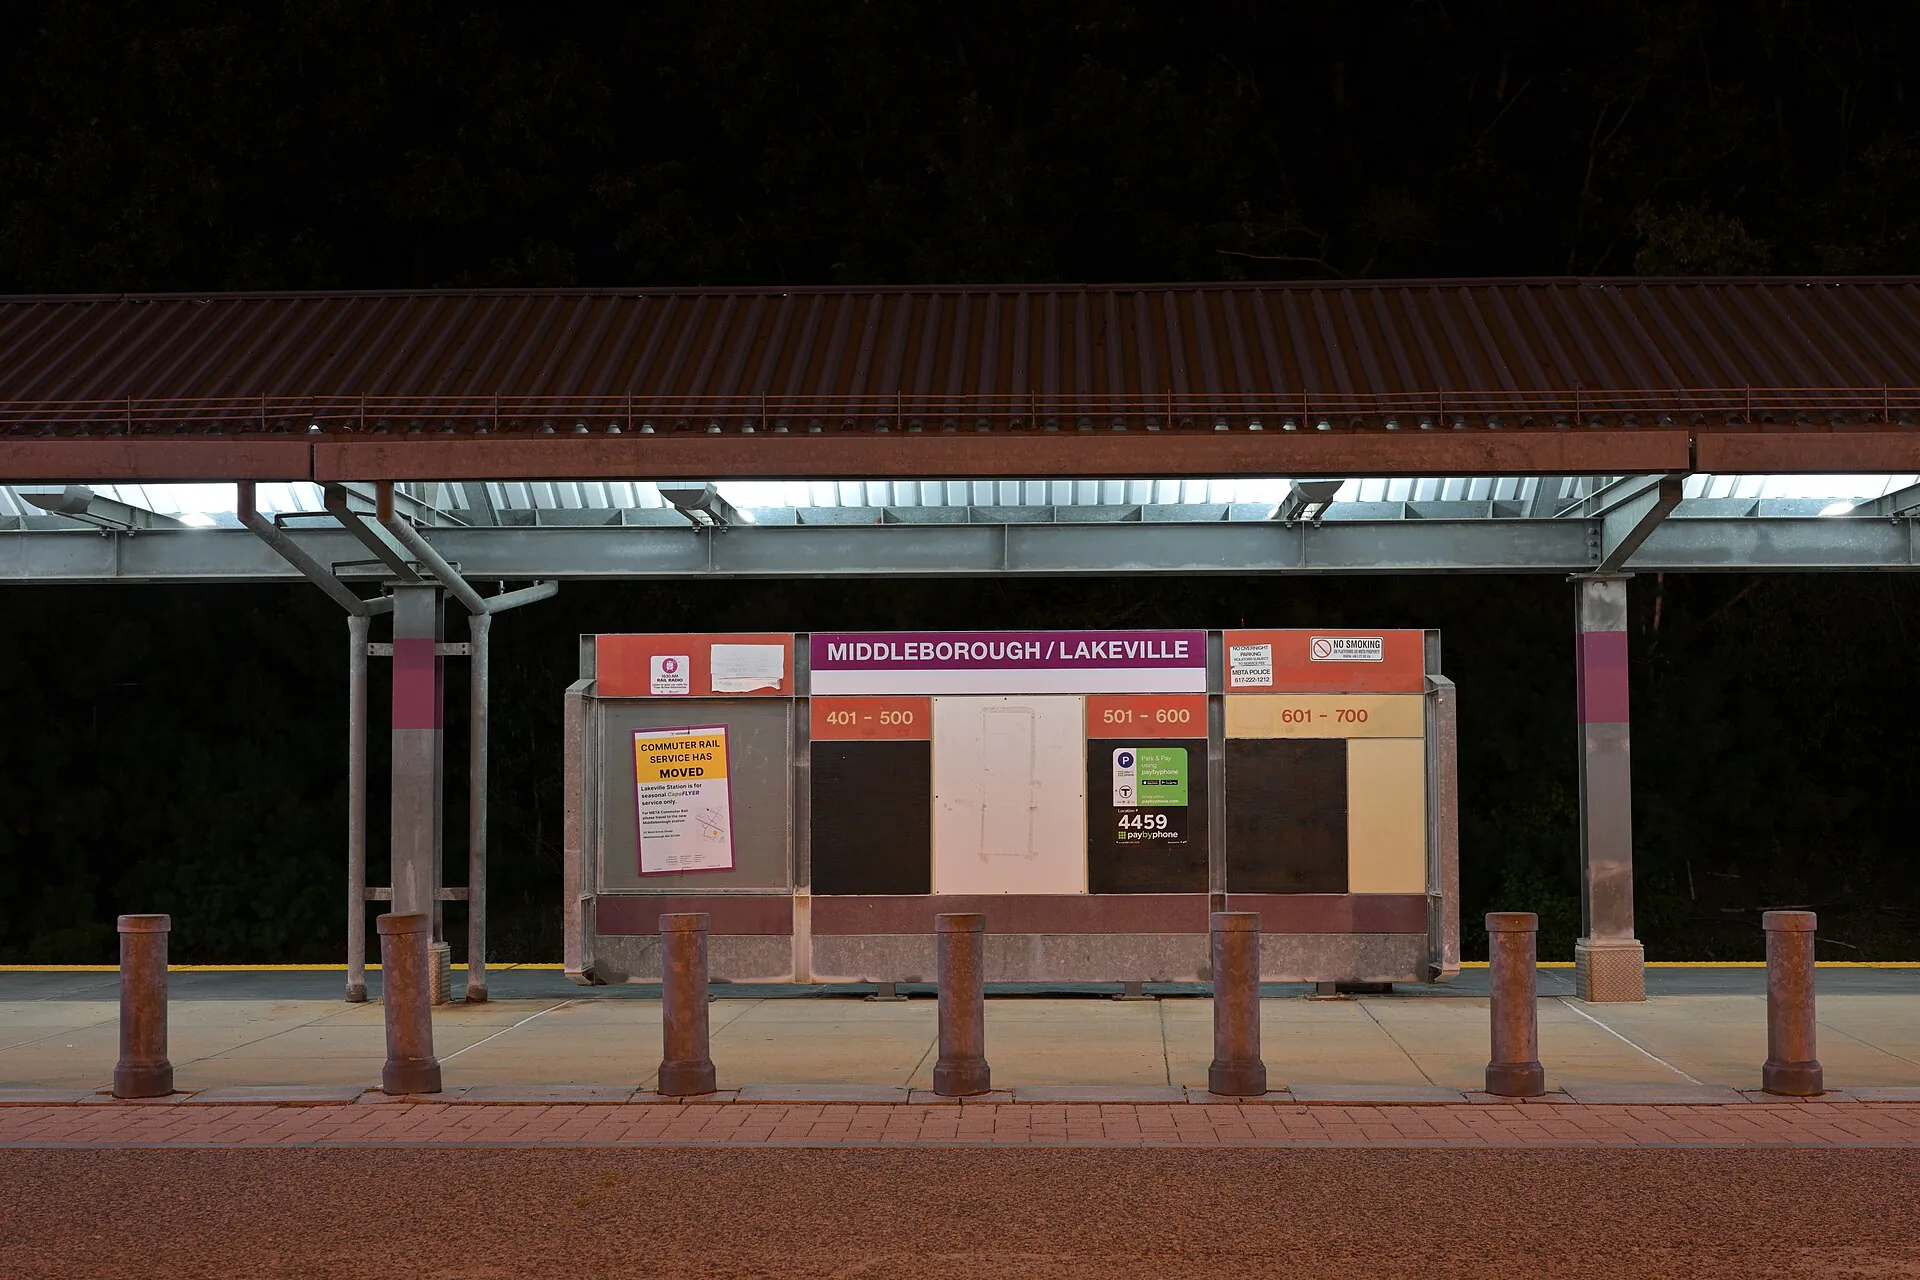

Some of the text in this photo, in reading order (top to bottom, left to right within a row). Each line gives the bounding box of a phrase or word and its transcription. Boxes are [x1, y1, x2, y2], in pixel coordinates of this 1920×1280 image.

[828, 642, 1040, 661] MIDDLEBOROUGH
[1060, 640, 1189, 660] LAKEVILLE
[1333, 640, 1380, 648] NO SMOKING
[827, 711, 856, 725] 401
[880, 711, 914, 725] 500
[1103, 709, 1133, 724] 501
[1156, 709, 1190, 724] 600
[1282, 709, 1311, 723] 601
[1335, 709, 1368, 723] 700
[641, 740, 720, 752] COMMUTER RAIL
[650, 754, 690, 764] SERVICE
[660, 767, 704, 778] MOVED
[1118, 814, 1167, 829] 4459
[1128, 831, 1178, 839] paybyphone
